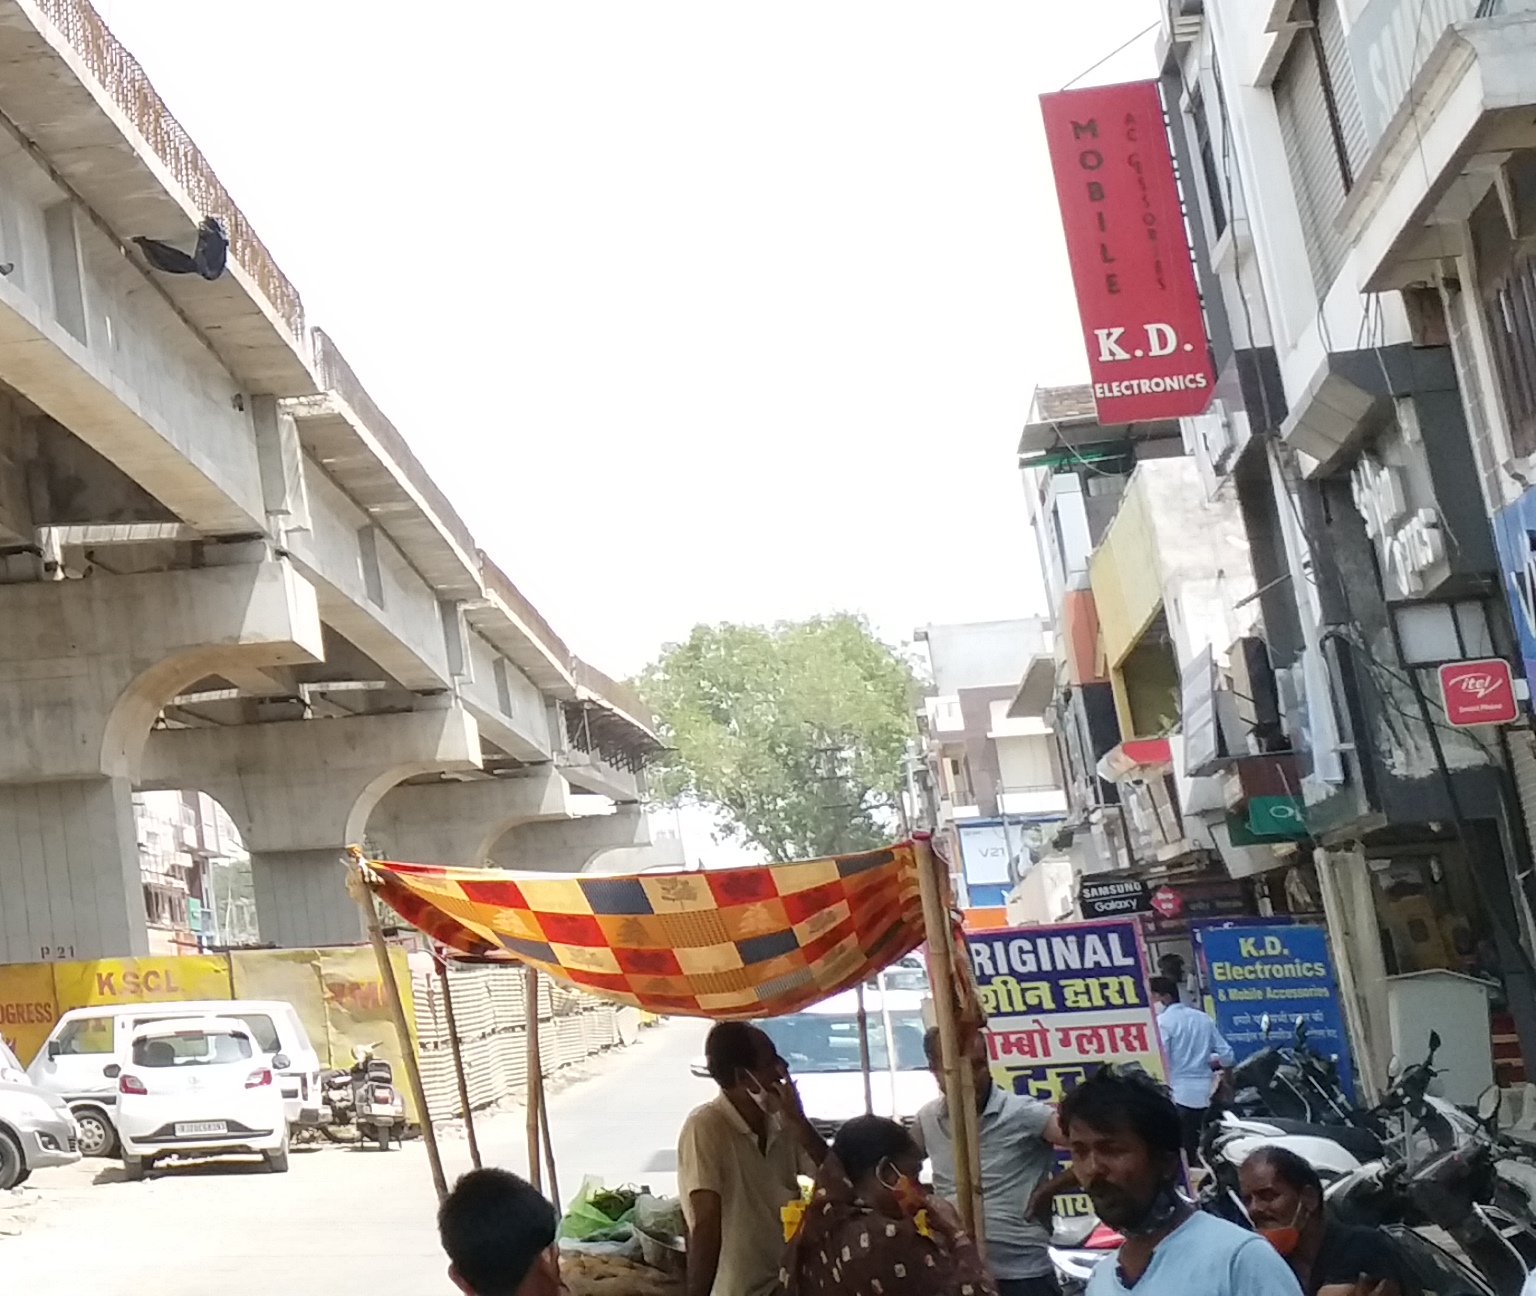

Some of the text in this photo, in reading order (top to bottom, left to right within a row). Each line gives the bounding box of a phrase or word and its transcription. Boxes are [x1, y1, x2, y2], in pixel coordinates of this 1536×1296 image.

[1070, 118, 1120, 295] MOBILE
[1094, 322, 1194, 361] K.D.
[1094, 372, 1207, 398] ELECTRONICS
[979, 847, 1005, 858] V21
[1083, 882, 1142, 898] SAMSUNG
[1095, 899, 1138, 913] Galaxy
[40, 945, 74, 959] P 21
[970, 932, 1135, 977] RIGINAL
[1239, 936, 1289, 958] K.D.
[1212, 959, 1326, 981] Electronics
[978, 975, 1139, 1014] शीन द्वारा
